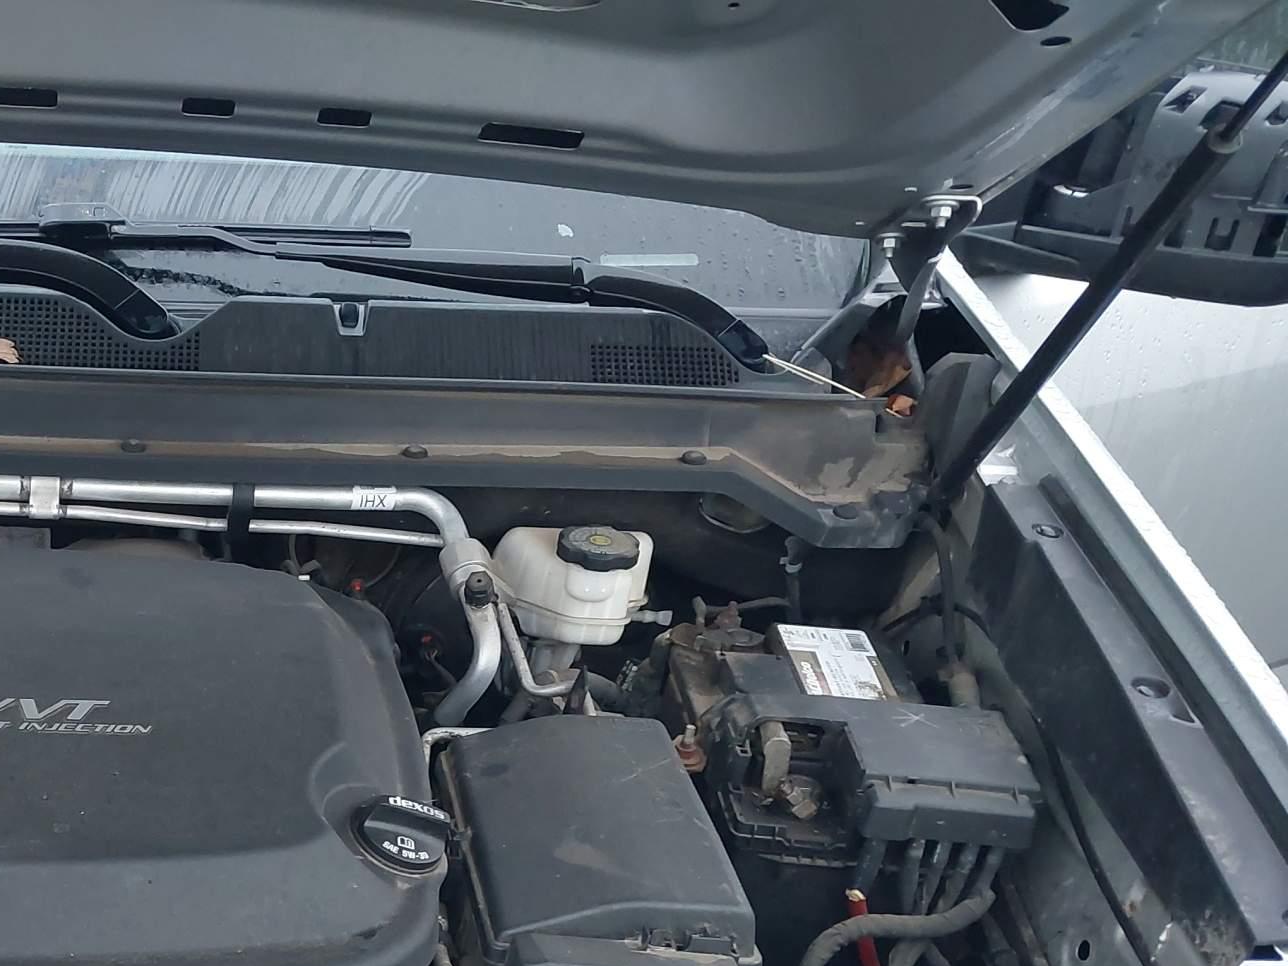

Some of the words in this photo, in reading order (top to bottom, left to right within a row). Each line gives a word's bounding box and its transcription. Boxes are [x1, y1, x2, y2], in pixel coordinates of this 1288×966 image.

[360, 494, 387, 508] IHX
[18, 721, 153, 735] INJECTION
[388, 795, 446, 820] dexos
[382, 840, 400, 854] SAE
